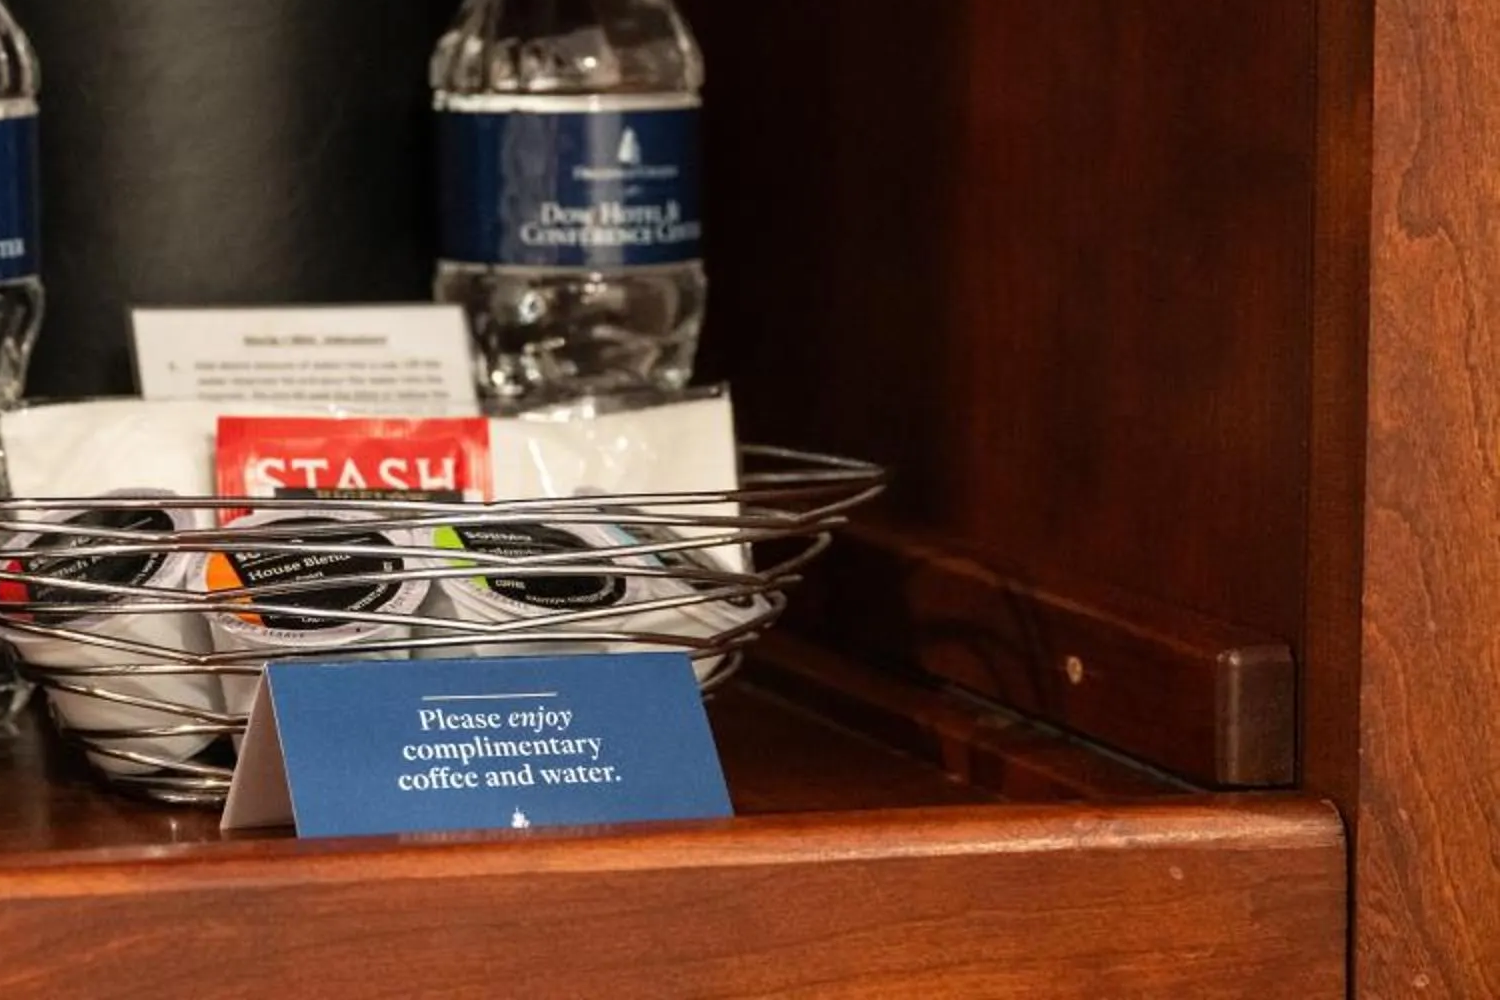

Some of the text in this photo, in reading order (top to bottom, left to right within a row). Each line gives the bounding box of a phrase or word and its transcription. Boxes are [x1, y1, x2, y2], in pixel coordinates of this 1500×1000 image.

[255, 457, 456, 491] STASH
[248, 562, 302, 581] House
[418, 706, 572, 733] Please enjoy
[403, 736, 602, 766] complimentary
[398, 763, 622, 791] coffee and water.
